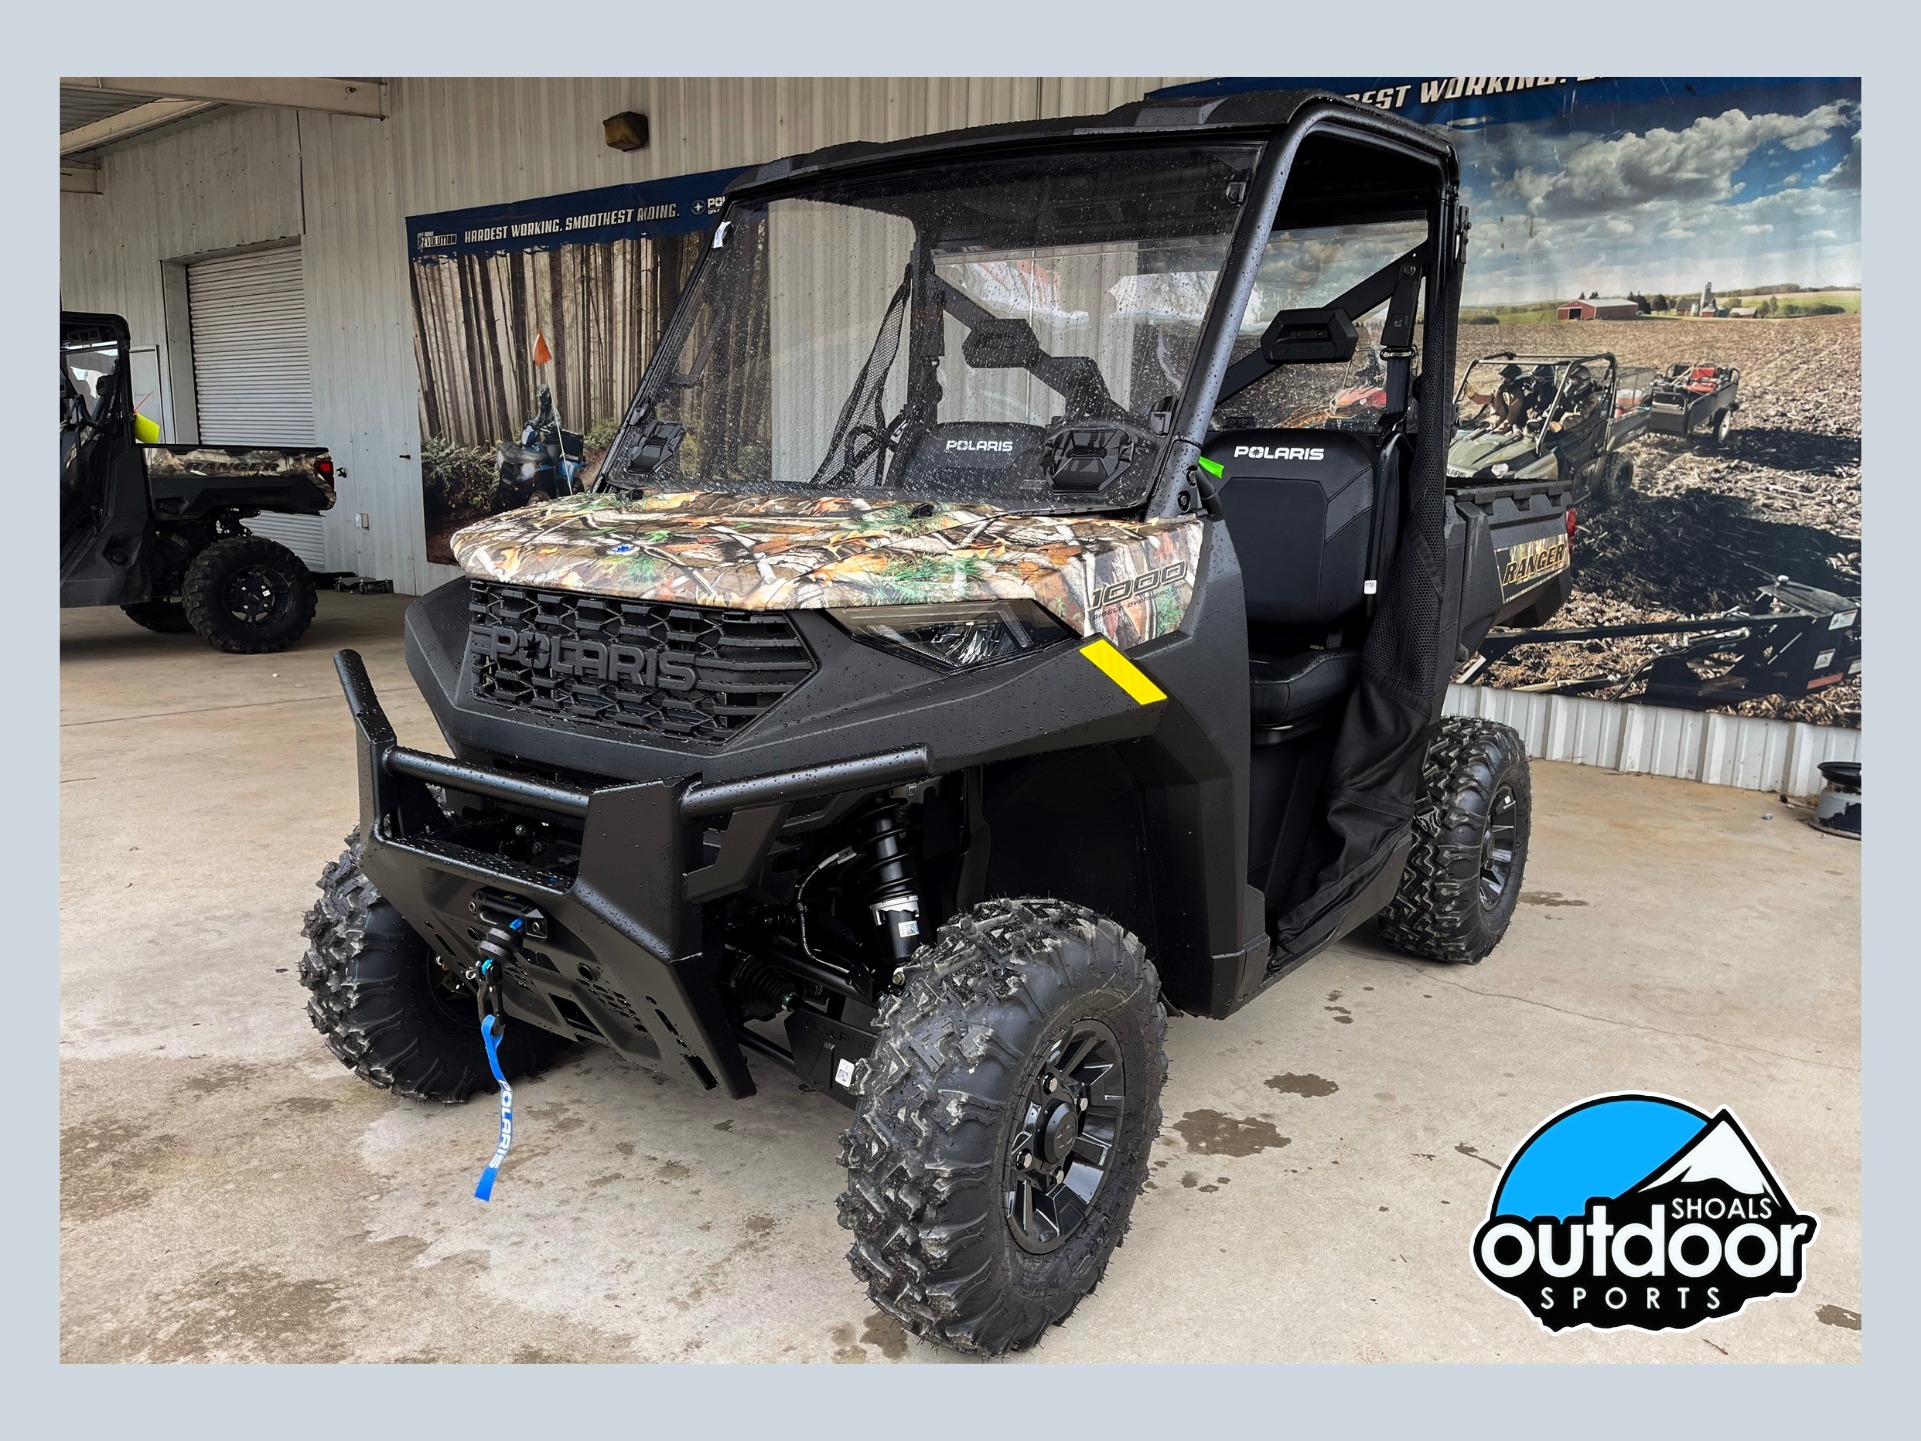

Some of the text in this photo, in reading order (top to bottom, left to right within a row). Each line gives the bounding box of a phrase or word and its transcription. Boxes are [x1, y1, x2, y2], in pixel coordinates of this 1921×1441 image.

[707, 196, 725, 208] PO
[464, 226, 508, 243] HARDEST
[511, 219, 563, 238] WORKING.
[565, 209, 634, 231] SMOOTHEST
[946, 440, 1013, 452] POLARIS
[1234, 446, 1324, 461] POLARIS
[185, 462, 281, 472] RANGER
[1502, 542, 1566, 586] RANGER
[1090, 560, 1187, 611] 1000
[491, 624, 698, 692] POLARIS
[489, 1079, 514, 1169] POLARIS
